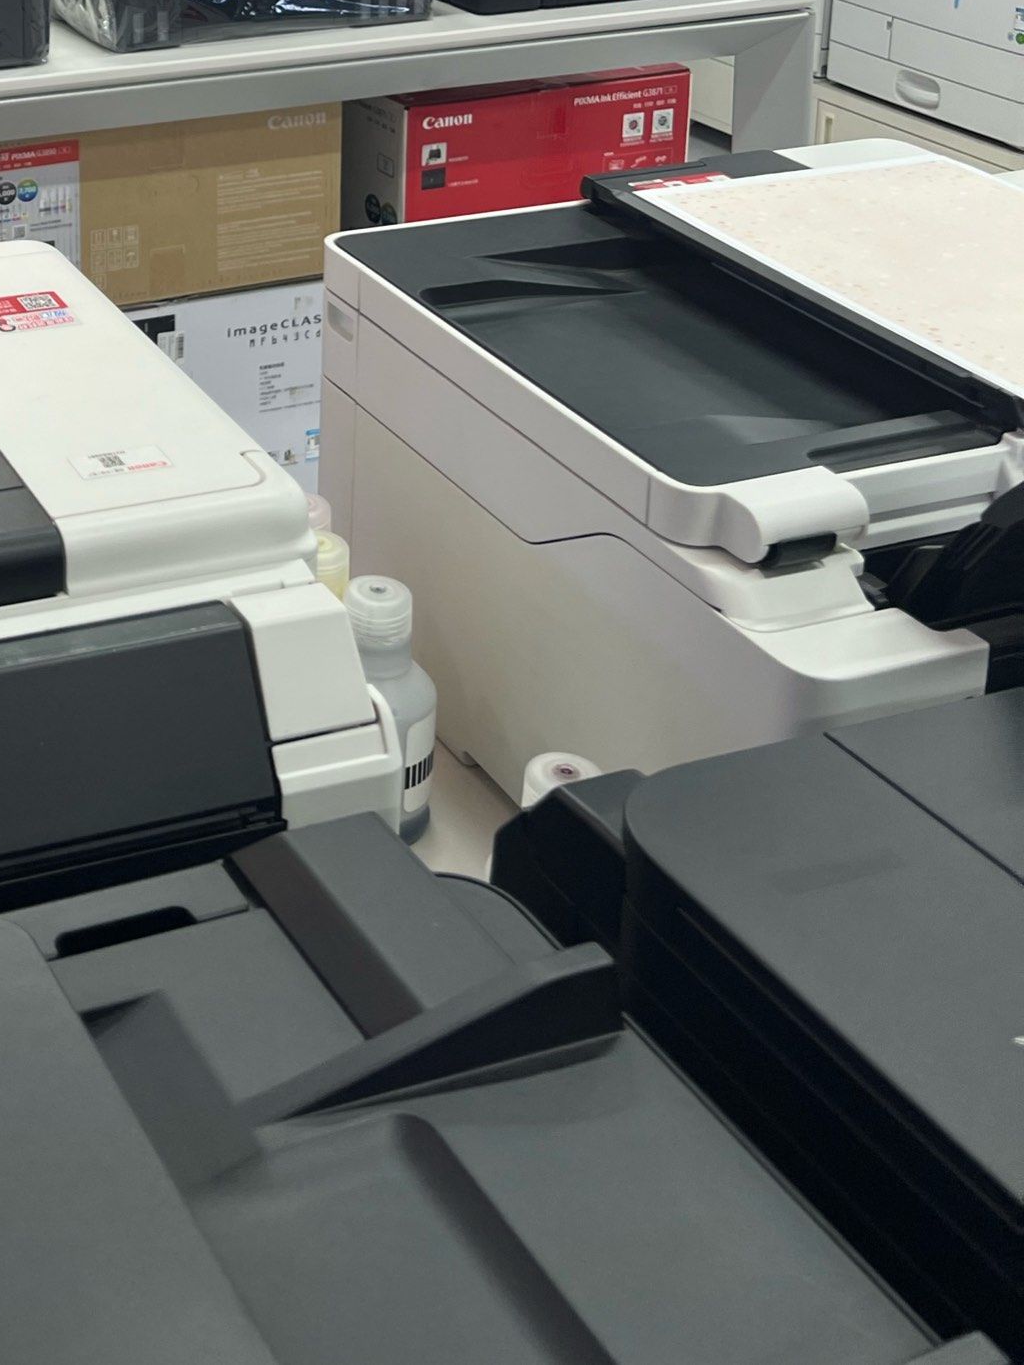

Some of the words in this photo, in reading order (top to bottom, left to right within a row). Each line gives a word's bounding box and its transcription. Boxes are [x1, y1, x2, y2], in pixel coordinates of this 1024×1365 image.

[574, 95, 600, 107] PIXMA
[600, 93, 611, 103] Ink
[612, 90, 642, 101] Efficient
[267, 111, 326, 130] Canon
[422, 114, 473, 130] Canon
[226, 314, 322, 338] imageCLAS
[249, 329, 321, 348] MF643Cd
